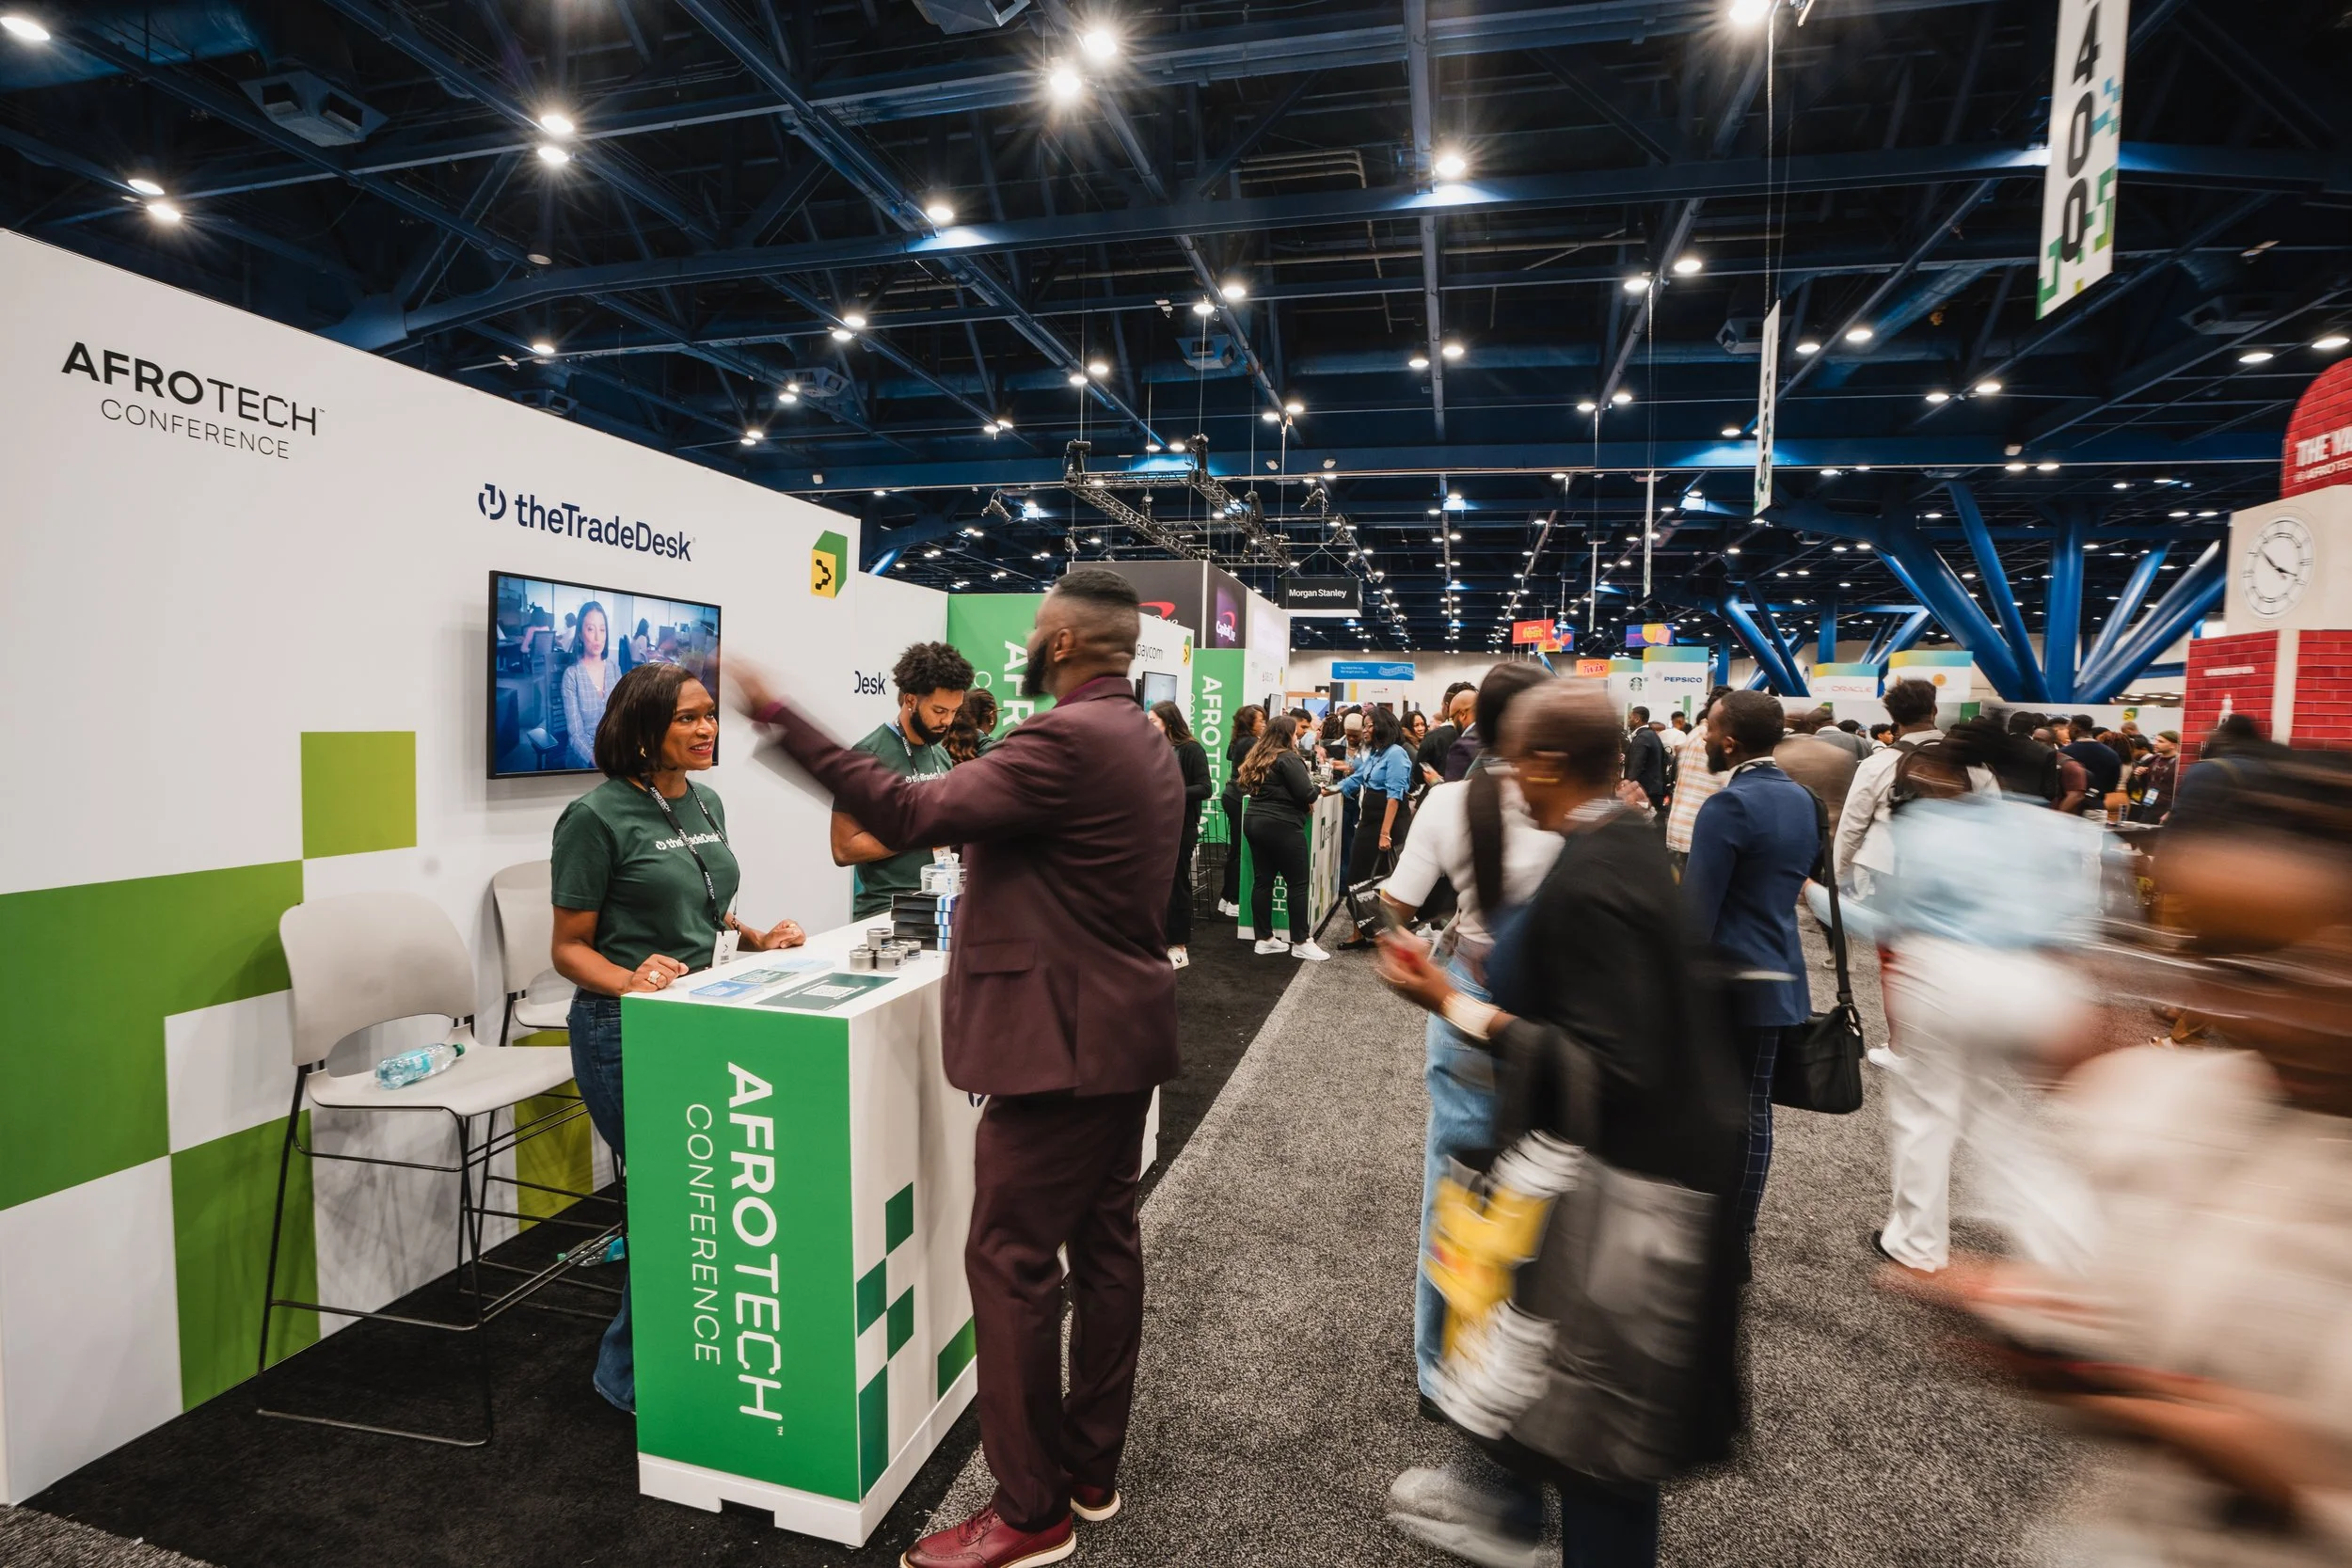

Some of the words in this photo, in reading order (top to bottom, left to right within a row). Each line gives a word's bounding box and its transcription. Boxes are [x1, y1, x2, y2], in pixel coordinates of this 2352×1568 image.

[2061, 0, 2103, 262] 400
[100, 397, 290, 459] CONFERENCE
[2296, 434, 2332, 467] THE
[515, 494, 691, 562] theTradeDesk
[1289, 589, 1317, 598] Morgan
[1318, 589, 1347, 598] Stanley
[1136, 644, 1163, 661] paycom
[1583, 662, 1605, 673] Twix
[1832, 685, 1873, 693] ORACLE
[686, 1102, 720, 1366] CONFERENCE
[726, 1061, 783, 1421] AFROTECH
